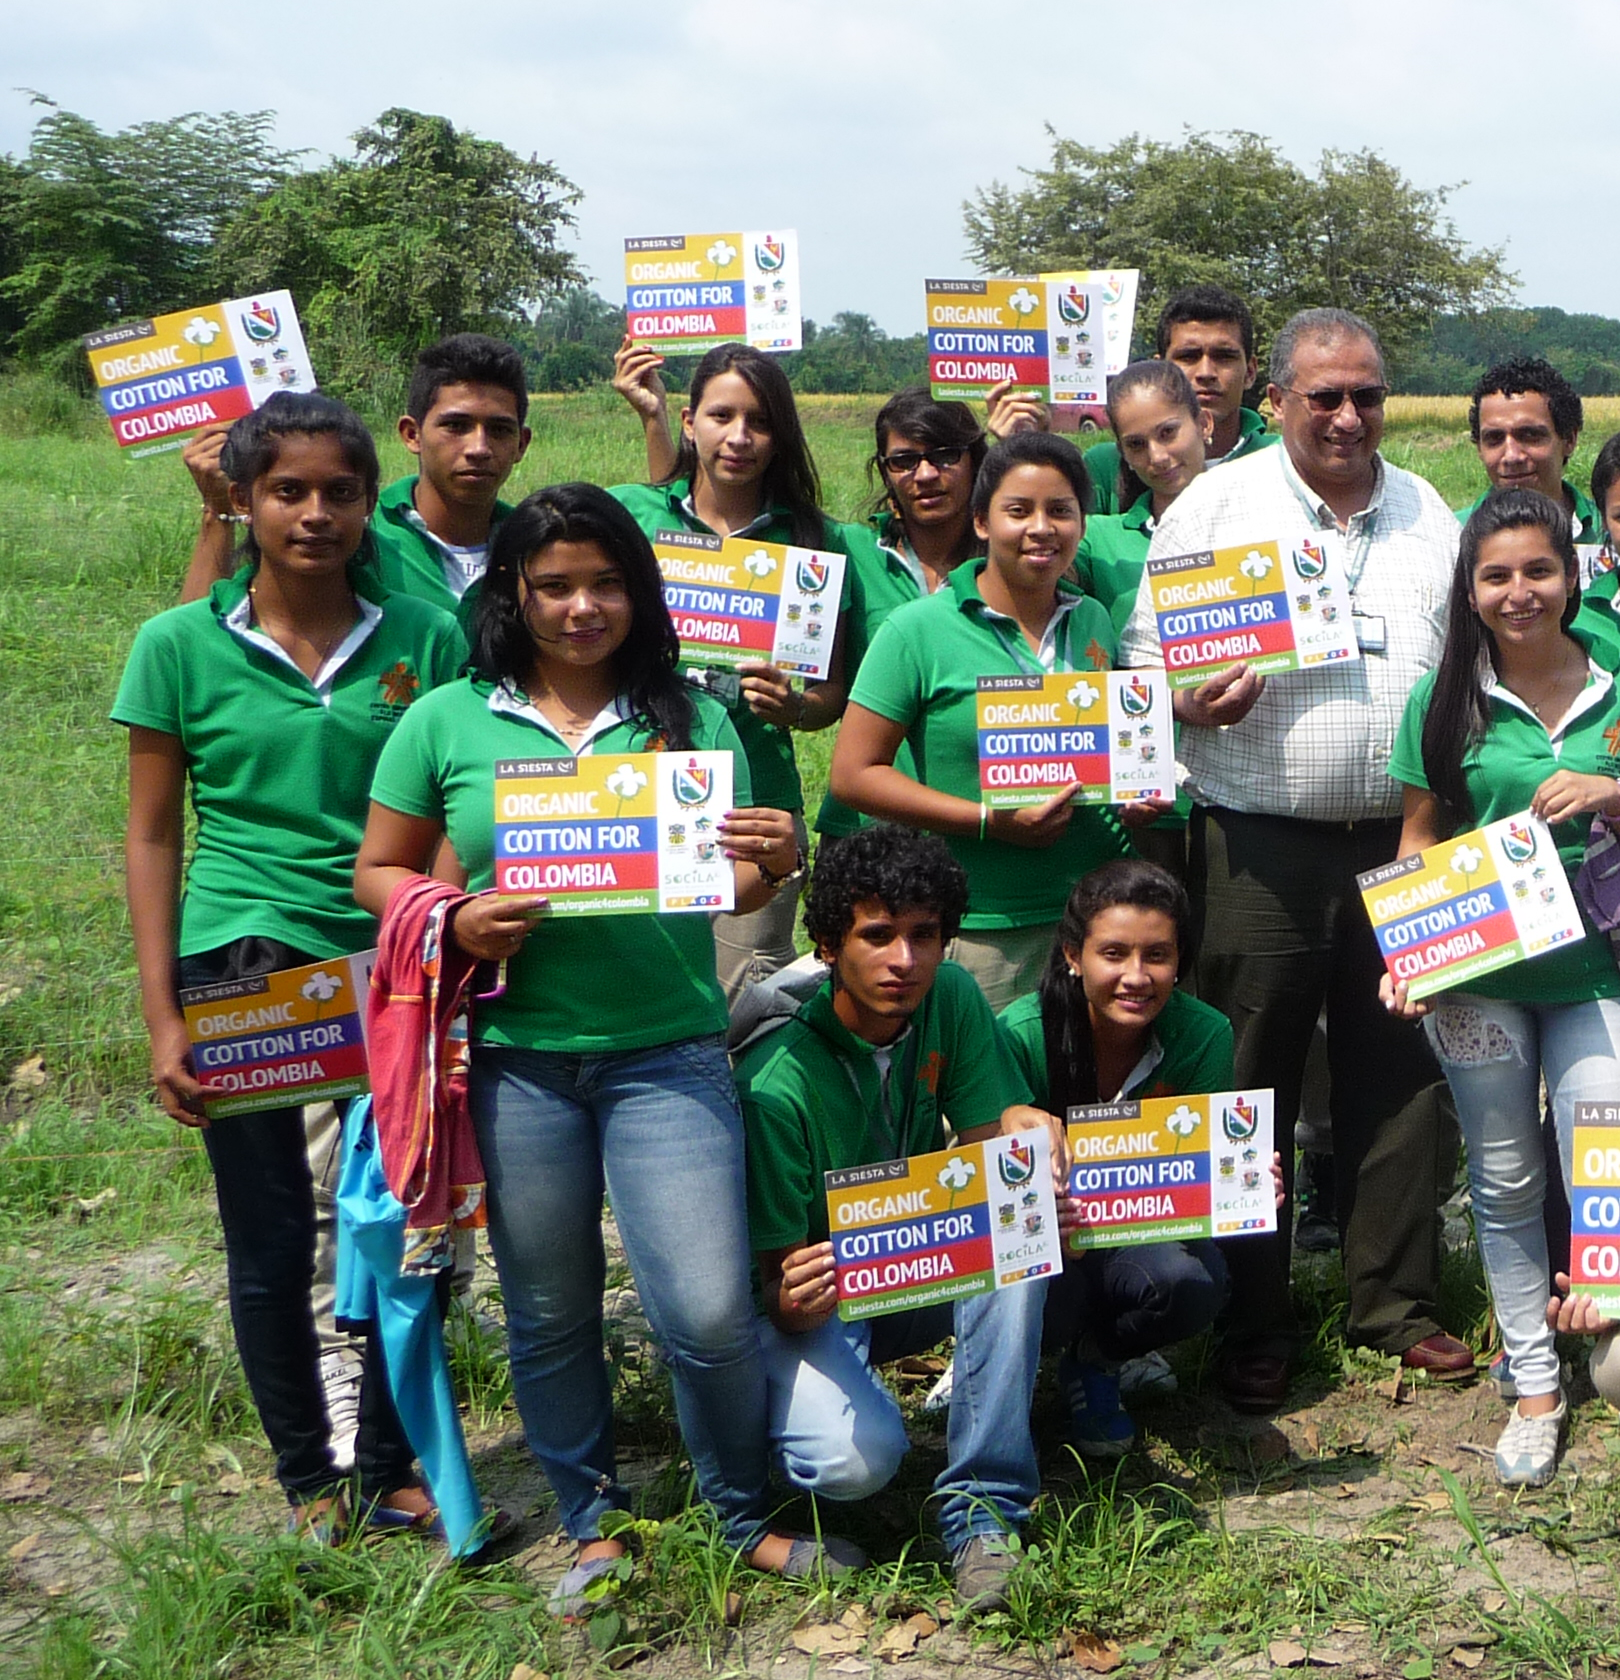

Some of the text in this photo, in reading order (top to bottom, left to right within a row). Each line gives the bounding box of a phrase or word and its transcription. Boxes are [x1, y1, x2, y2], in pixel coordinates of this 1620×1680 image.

[631, 262, 701, 280] ORGANIC
[632, 287, 733, 307] COTTON FOR
[633, 315, 715, 334] COLOMBIA
[932, 306, 1003, 325] ORGANIC
[89, 337, 102, 346] LA
[934, 332, 1035, 353] COTTON FOR
[99, 345, 184, 380] ORGANIC
[936, 360, 1018, 380] COLOMBIA
[107, 367, 229, 409] COTTON FOR
[117, 401, 217, 438] COLOMBIA
[659, 532, 703, 545] LA SIESTA
[659, 556, 736, 585] ORGANIC
[1151, 557, 1195, 571] LA SIESTA
[665, 583, 765, 618] OTTON FOR
[1157, 577, 1237, 607] ORGANIC
[673, 613, 739, 643] LOMBIA
[1162, 600, 1276, 636] COTTON FOR
[1168, 634, 1261, 665] COLOMBIA
[995, 679, 1023, 687] SIESTA
[984, 704, 1061, 724] ORGANIC
[985, 732, 1095, 753] COTTON FOR
[500, 763, 553, 773] LA SIESTA
[986, 763, 1077, 783] COLOMBIA
[503, 792, 598, 817] ORGANIC
[504, 826, 641, 852] COTTON FOR
[505, 863, 616, 888] COLOMBIA
[1362, 876, 1375, 885] LA
[1372, 875, 1452, 920] ORGANIC
[1382, 892, 1495, 949] COTTON FOR
[1393, 930, 1485, 978] COLOMBIA
[188, 992, 203, 1001] LA
[196, 1002, 297, 1037] ORGANIC
[202, 1024, 346, 1066] COTTON FOR
[1073, 1107, 1119, 1119] LA SIESTA
[1582, 1109, 1599, 1119] LA
[1075, 1132, 1159, 1158] ORGANIC
[832, 1167, 885, 1186] LA SIESTA
[1076, 1160, 1195, 1190] COTTON FOR
[837, 1188, 932, 1227] ORGANIC
[840, 1213, 974, 1261] COTTON FOR
[843, 1252, 953, 1296] COLOMBIA
[849, 1278, 985, 1318] lasiesta.com/organic4colombia
